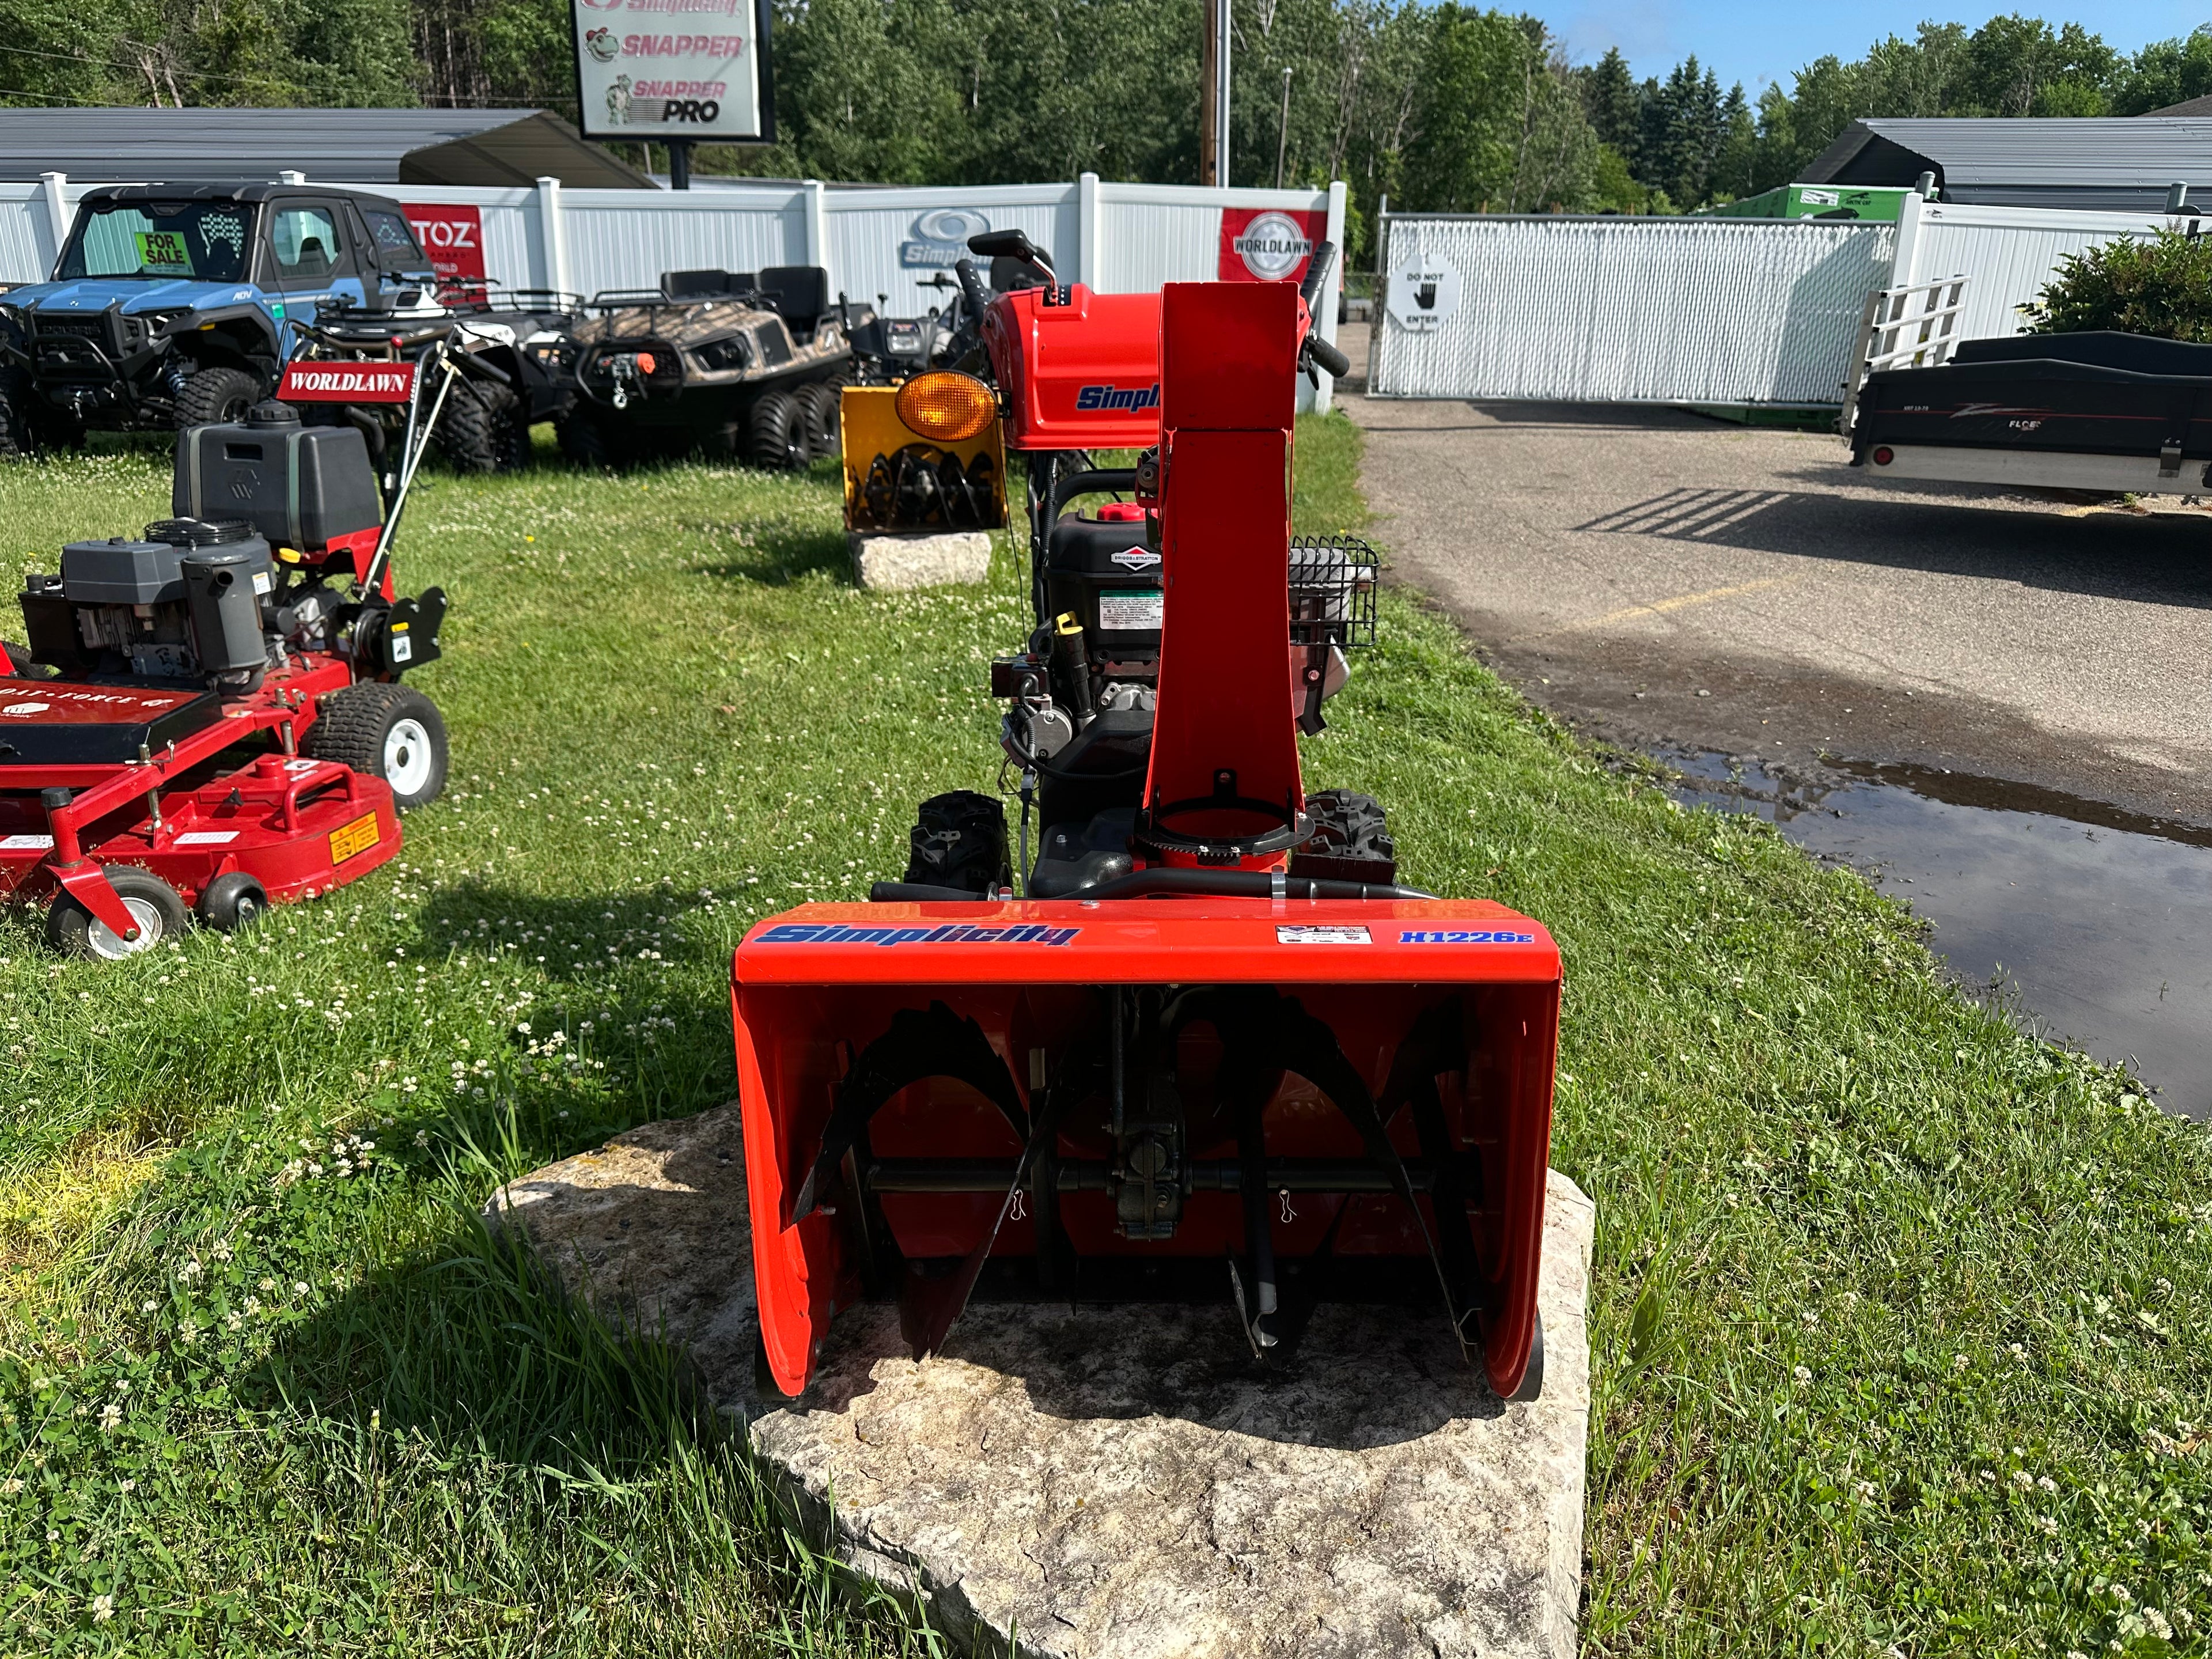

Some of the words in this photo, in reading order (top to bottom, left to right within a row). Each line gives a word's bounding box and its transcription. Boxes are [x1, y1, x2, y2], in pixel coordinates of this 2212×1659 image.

[622, 35, 742, 57] SNAPPER
[633, 81, 726, 98] SNAPPER
[662, 100, 719, 123] PRO
[145, 234, 176, 249] FOR
[1235, 238, 1310, 254] WORLDLAWN
[145, 249, 185, 264] SALE
[1407, 272, 1421, 282] DO
[1423, 272, 1444, 282] NOT
[1406, 315, 1438, 323] ENTER
[290, 372, 407, 392] WORLDLAWN
[752, 925, 1083, 946] Simplicity
